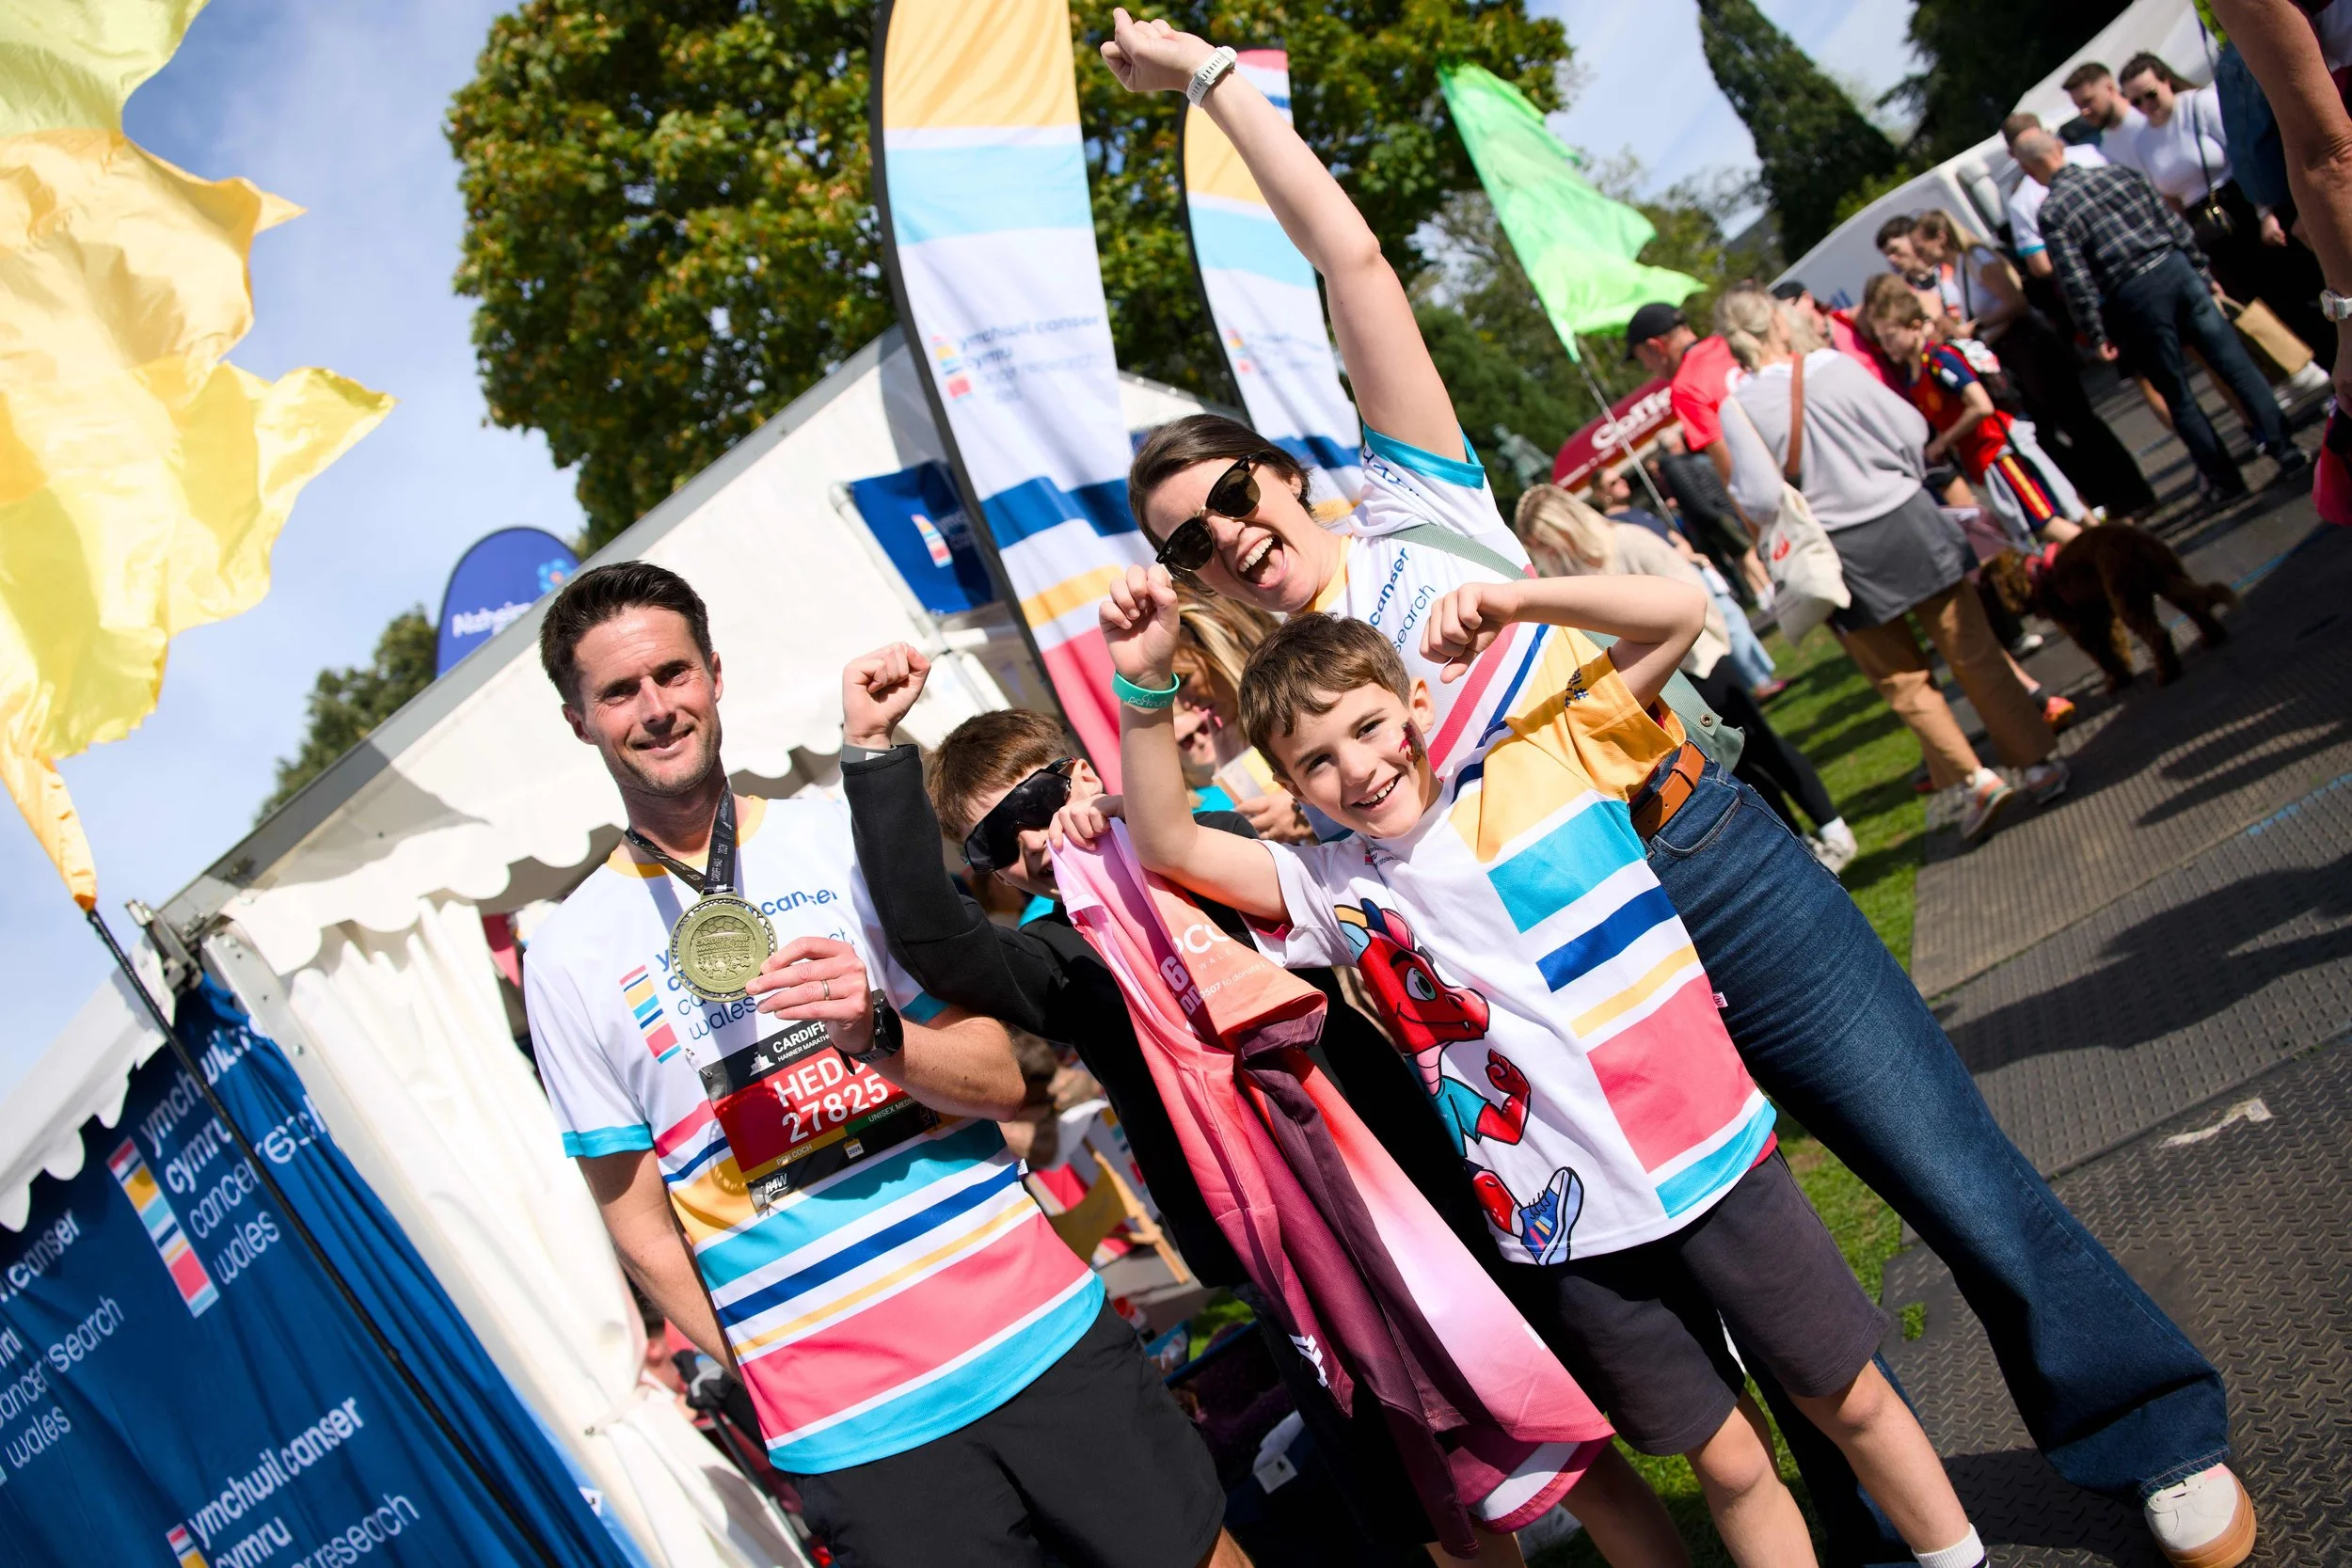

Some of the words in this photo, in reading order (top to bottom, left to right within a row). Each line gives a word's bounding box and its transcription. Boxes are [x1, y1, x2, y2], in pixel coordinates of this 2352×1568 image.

[1369, 547, 1409, 626] canser
[1392, 584, 1436, 655] search
[690, 995, 757, 1040] wales
[777, 1046, 803, 1062] HANNER
[803, 1034, 831, 1051] MARATH
[782, 1073, 889, 1144] 27825
[868, 1106, 895, 1122] UNISEX
[896, 1097, 916, 1111] MEDIU
[792, 1144, 813, 1158] COCH
[214, 1212, 280, 1285] wales
[0, 1359, 49, 1430] ancer
[5, 1405, 72, 1469] wales
[188, 1448, 290, 1551] ymchwil
[280, 1396, 364, 1476] canser
[313, 1493, 421, 1568] reseach
